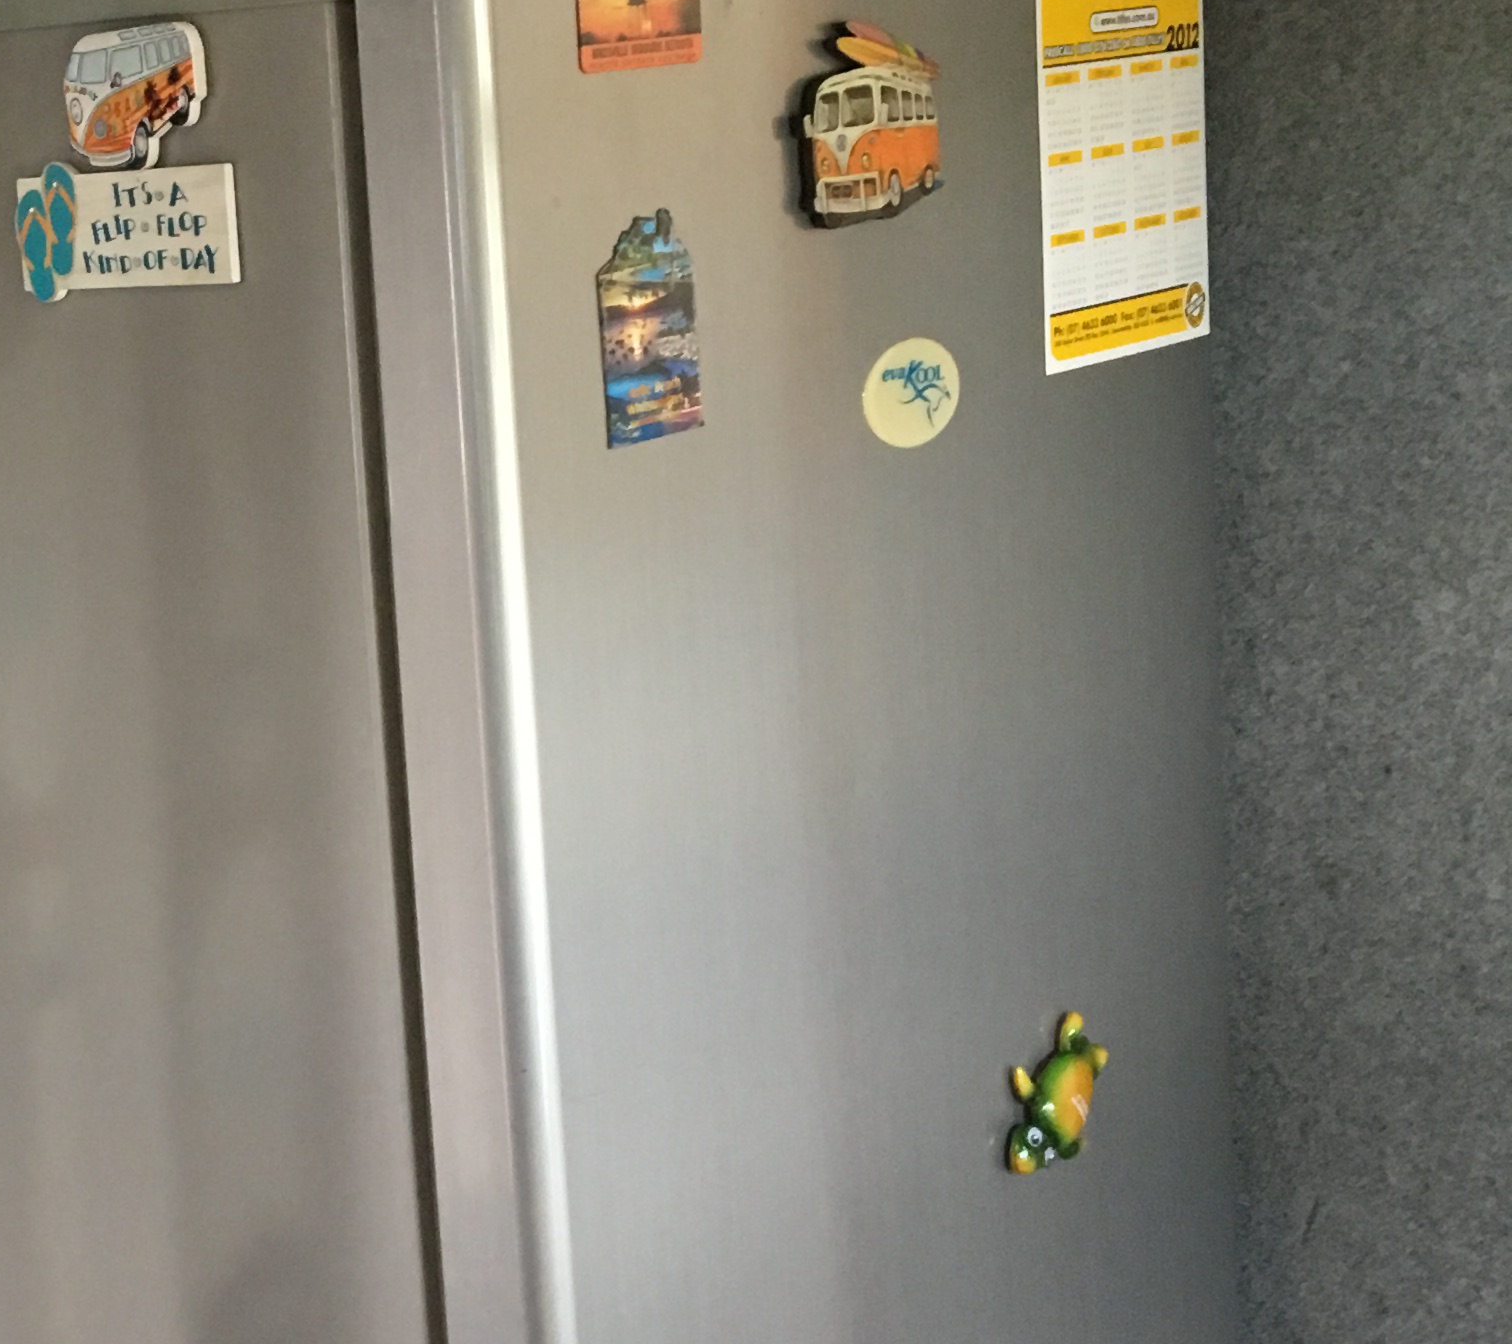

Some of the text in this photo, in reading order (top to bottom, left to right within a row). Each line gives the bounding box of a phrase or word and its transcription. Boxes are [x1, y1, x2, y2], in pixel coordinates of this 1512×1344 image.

[1166, 22, 1199, 51] 2012
[169, 181, 188, 206] A
[91, 212, 207, 245] FLIP FLOP
[82, 244, 219, 275] KIND OF DAY
